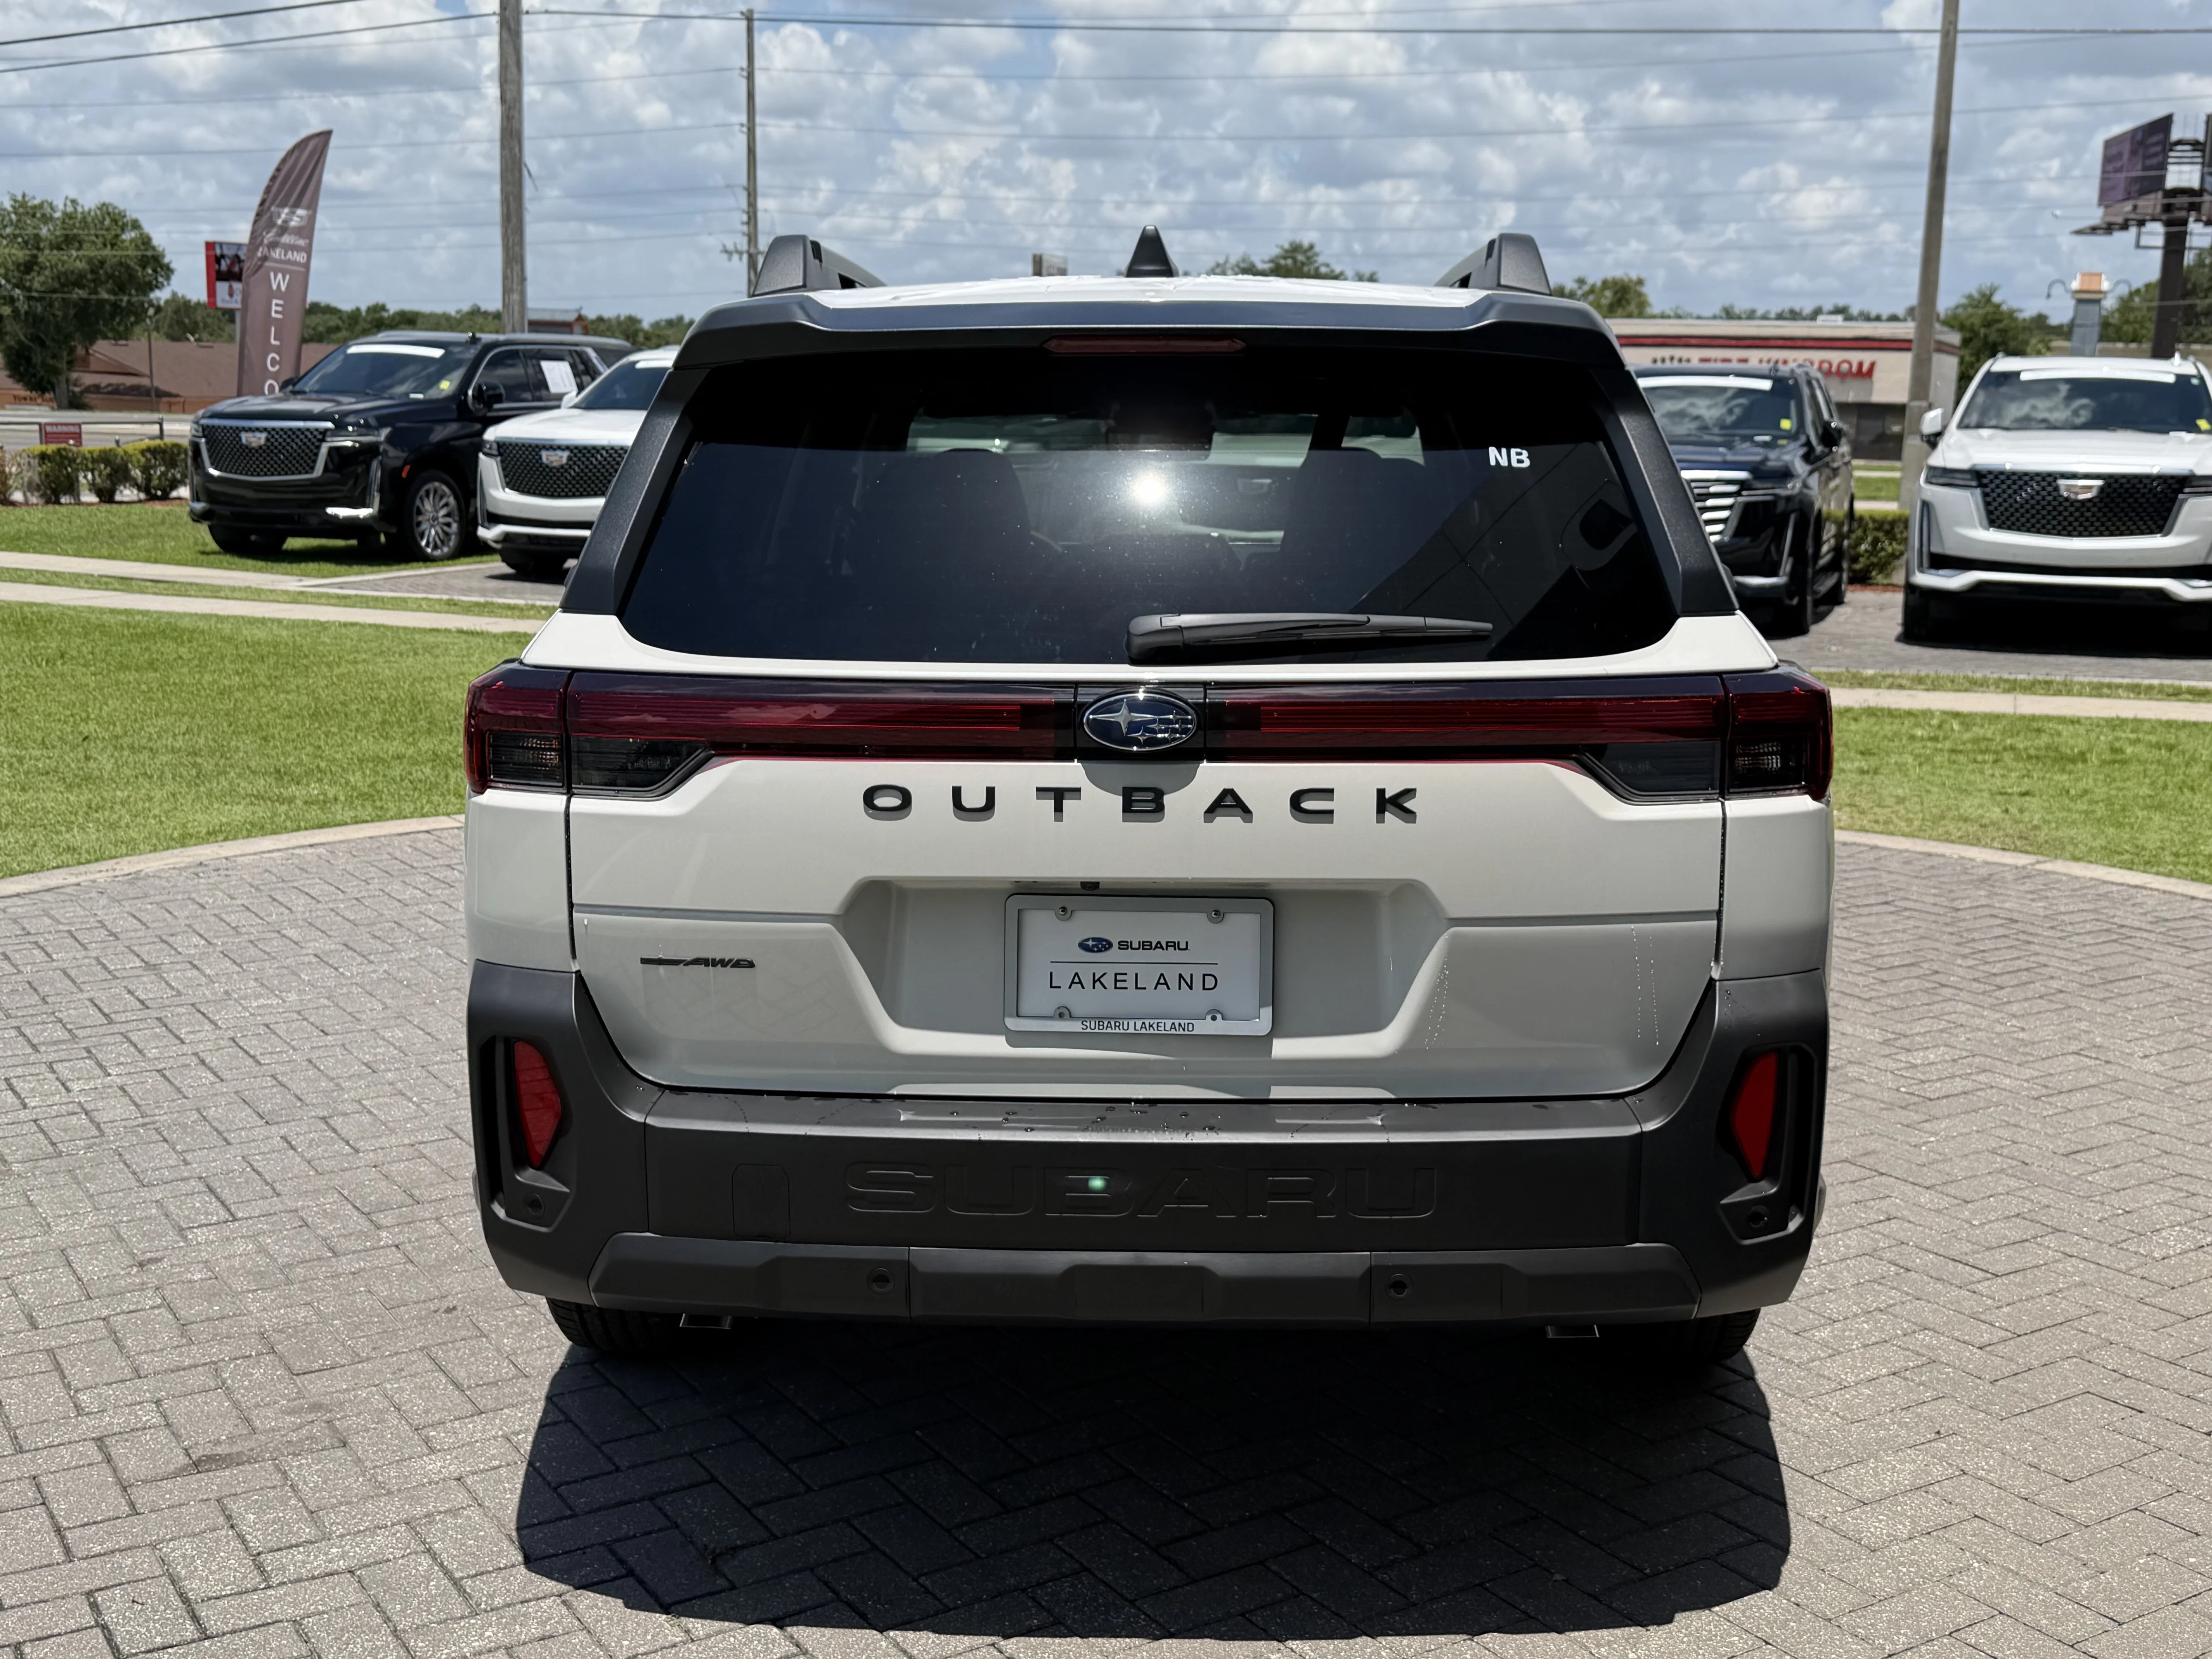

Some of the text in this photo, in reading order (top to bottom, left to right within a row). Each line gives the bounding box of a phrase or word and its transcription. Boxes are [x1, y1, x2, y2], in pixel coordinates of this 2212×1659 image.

[1489, 447, 1530, 467] NB
[863, 784, 1417, 824] OUTBACK
[1118, 940, 1188, 951] SUBARU
[1049, 972, 1218, 991] LAKELAND
[1081, 1020, 1194, 1032] SUBARU LAKELAND
[844, 1162, 1436, 1219] SUBARU
